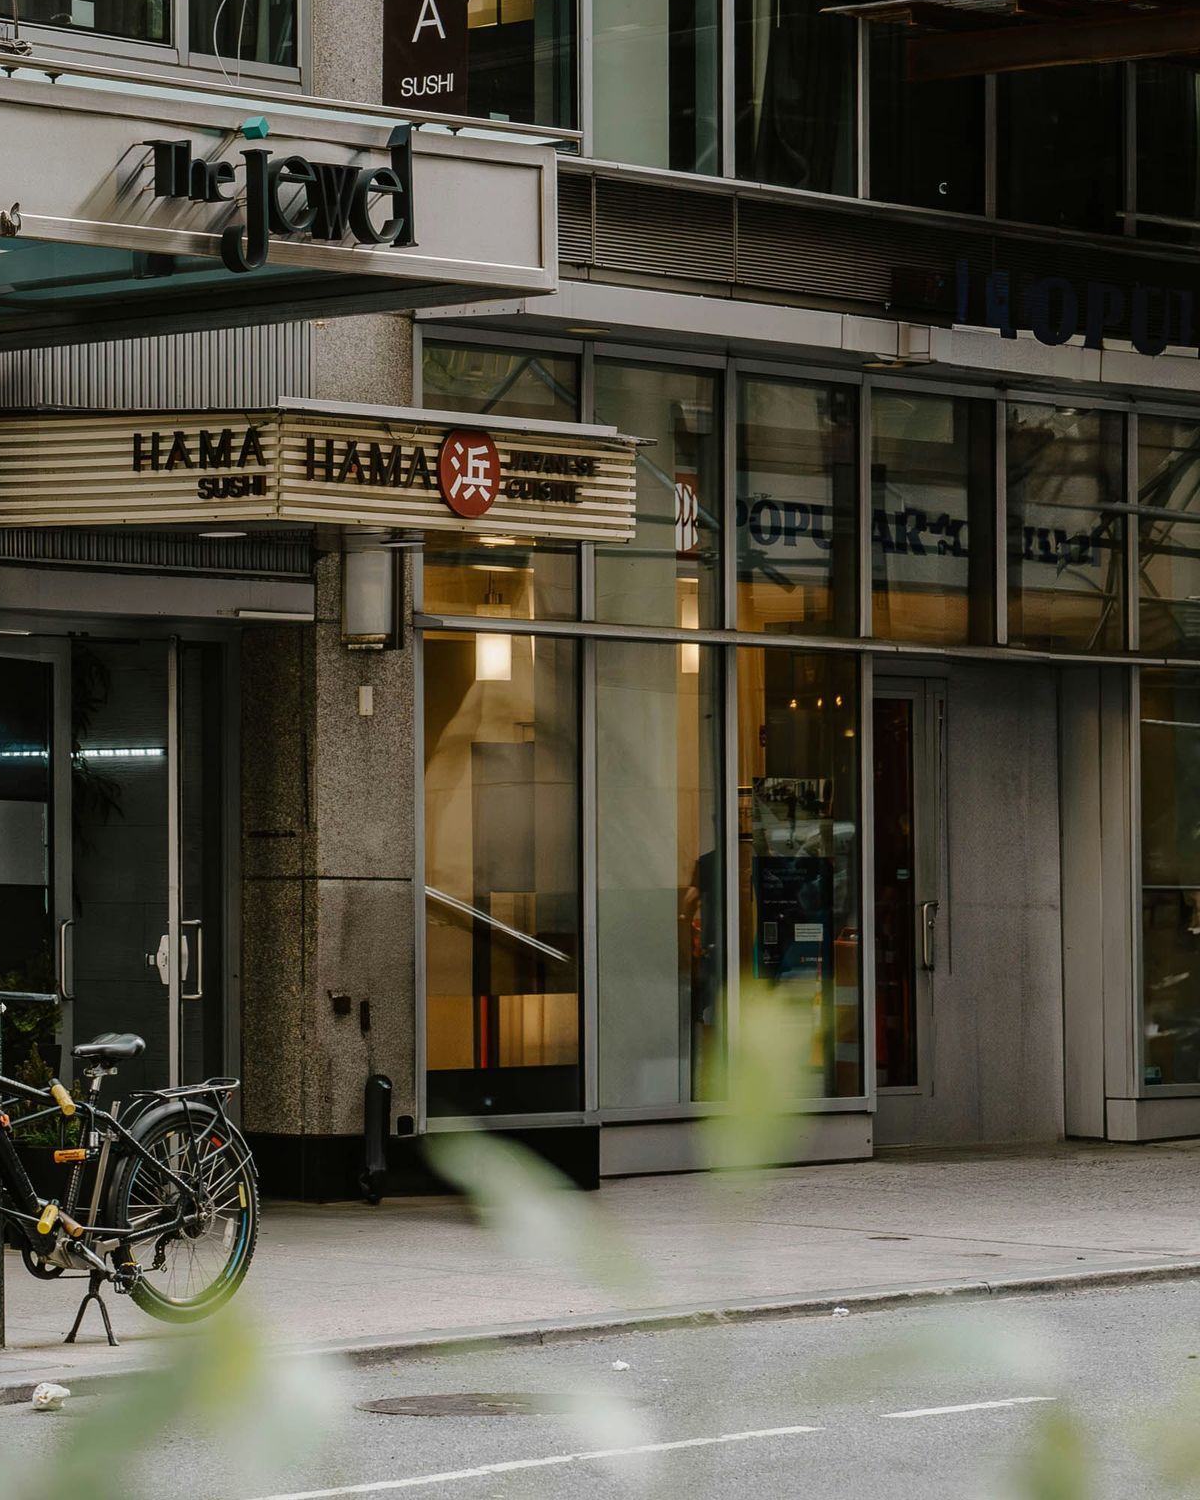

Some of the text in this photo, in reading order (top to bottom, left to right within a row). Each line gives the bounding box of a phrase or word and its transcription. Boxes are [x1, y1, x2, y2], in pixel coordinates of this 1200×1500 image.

[400, 72, 455, 98] SUSHI
[142, 115, 420, 274] The jewel
[132, 426, 267, 472] HAMA
[305, 437, 437, 490] HAMA
[509, 450, 601, 477] JAPANESE
[197, 475, 267, 500] SUSHI
[448, 440, 493, 503] 浜
[505, 478, 583, 504] CUISINE
